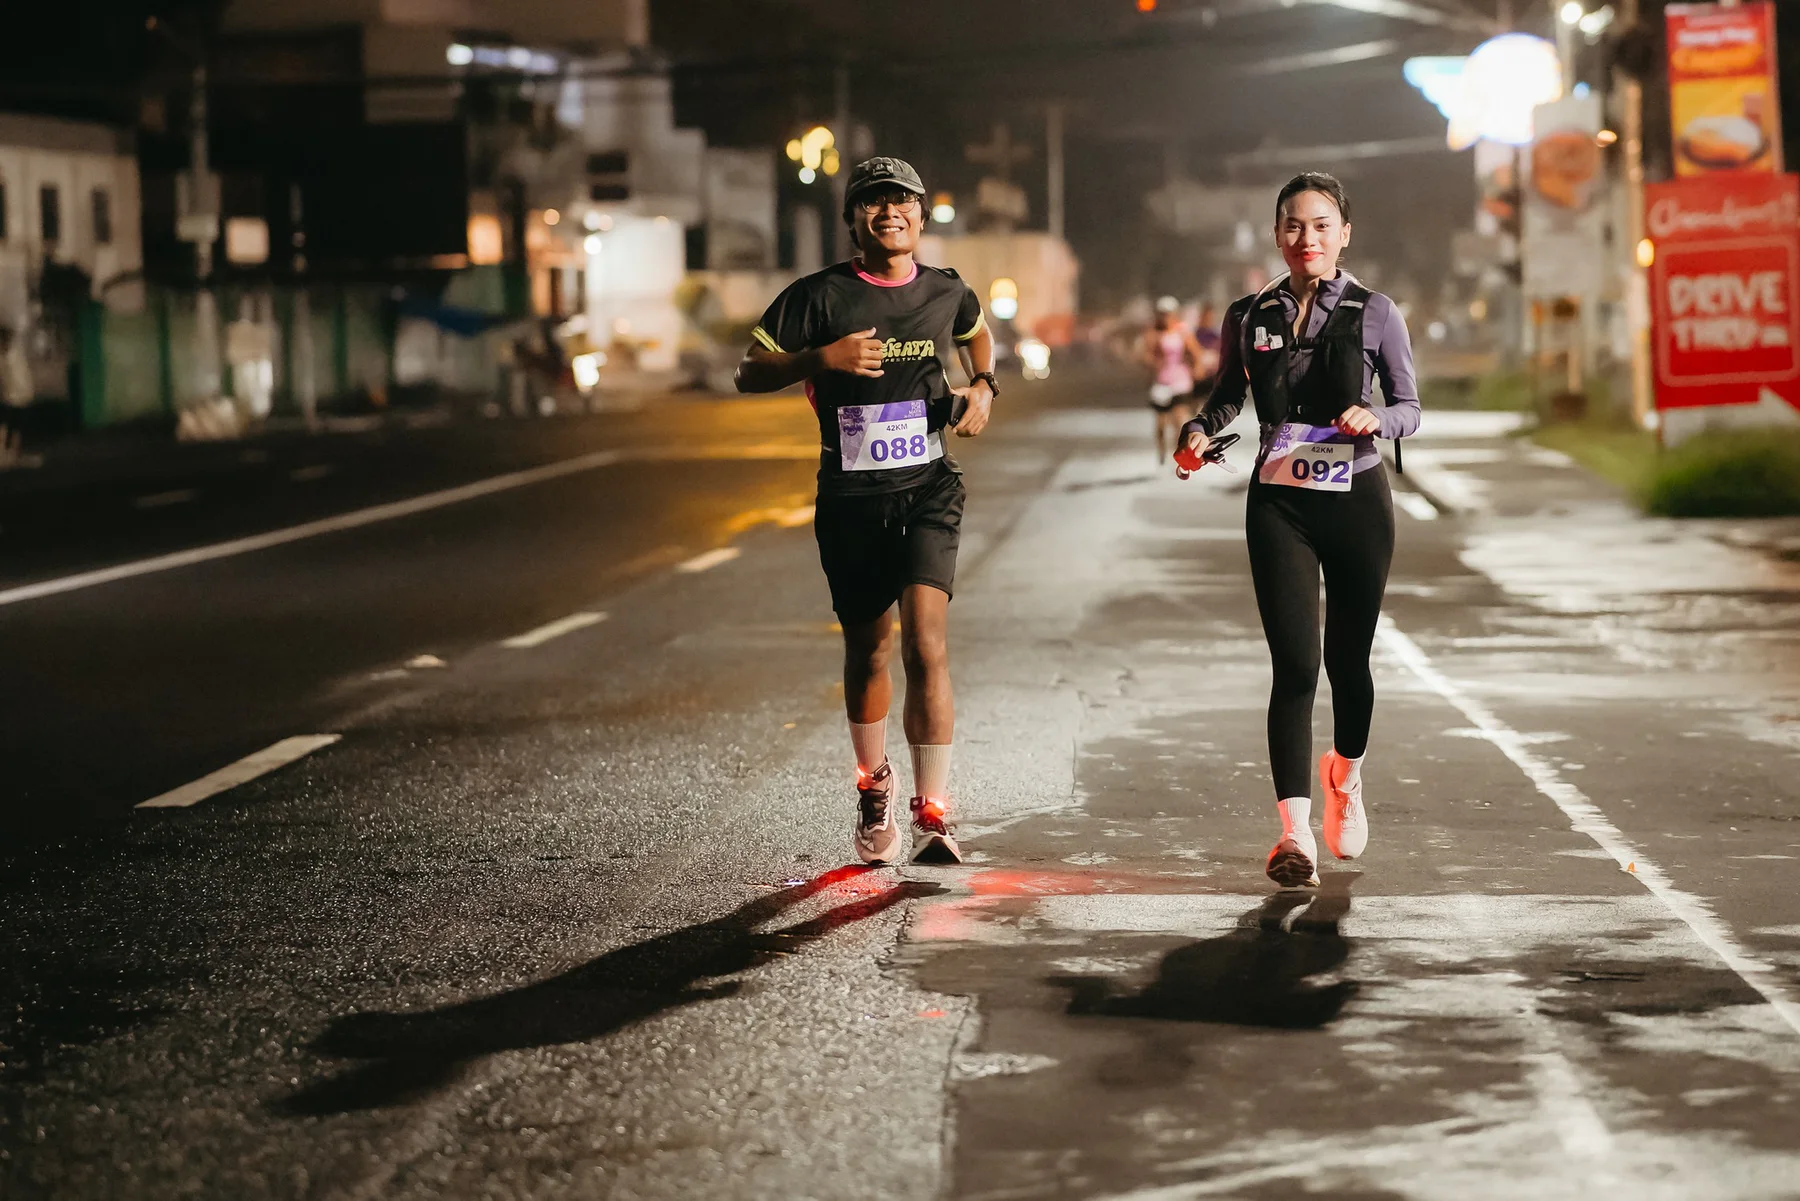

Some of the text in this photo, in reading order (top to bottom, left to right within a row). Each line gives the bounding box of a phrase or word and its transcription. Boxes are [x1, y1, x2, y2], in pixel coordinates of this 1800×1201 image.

[881, 337, 935, 358] EKATA
[886, 423, 908, 432] 42KM
[870, 434, 926, 462] 088
[1311, 446, 1334, 454] 42KM
[1291, 458, 1350, 484] 092
